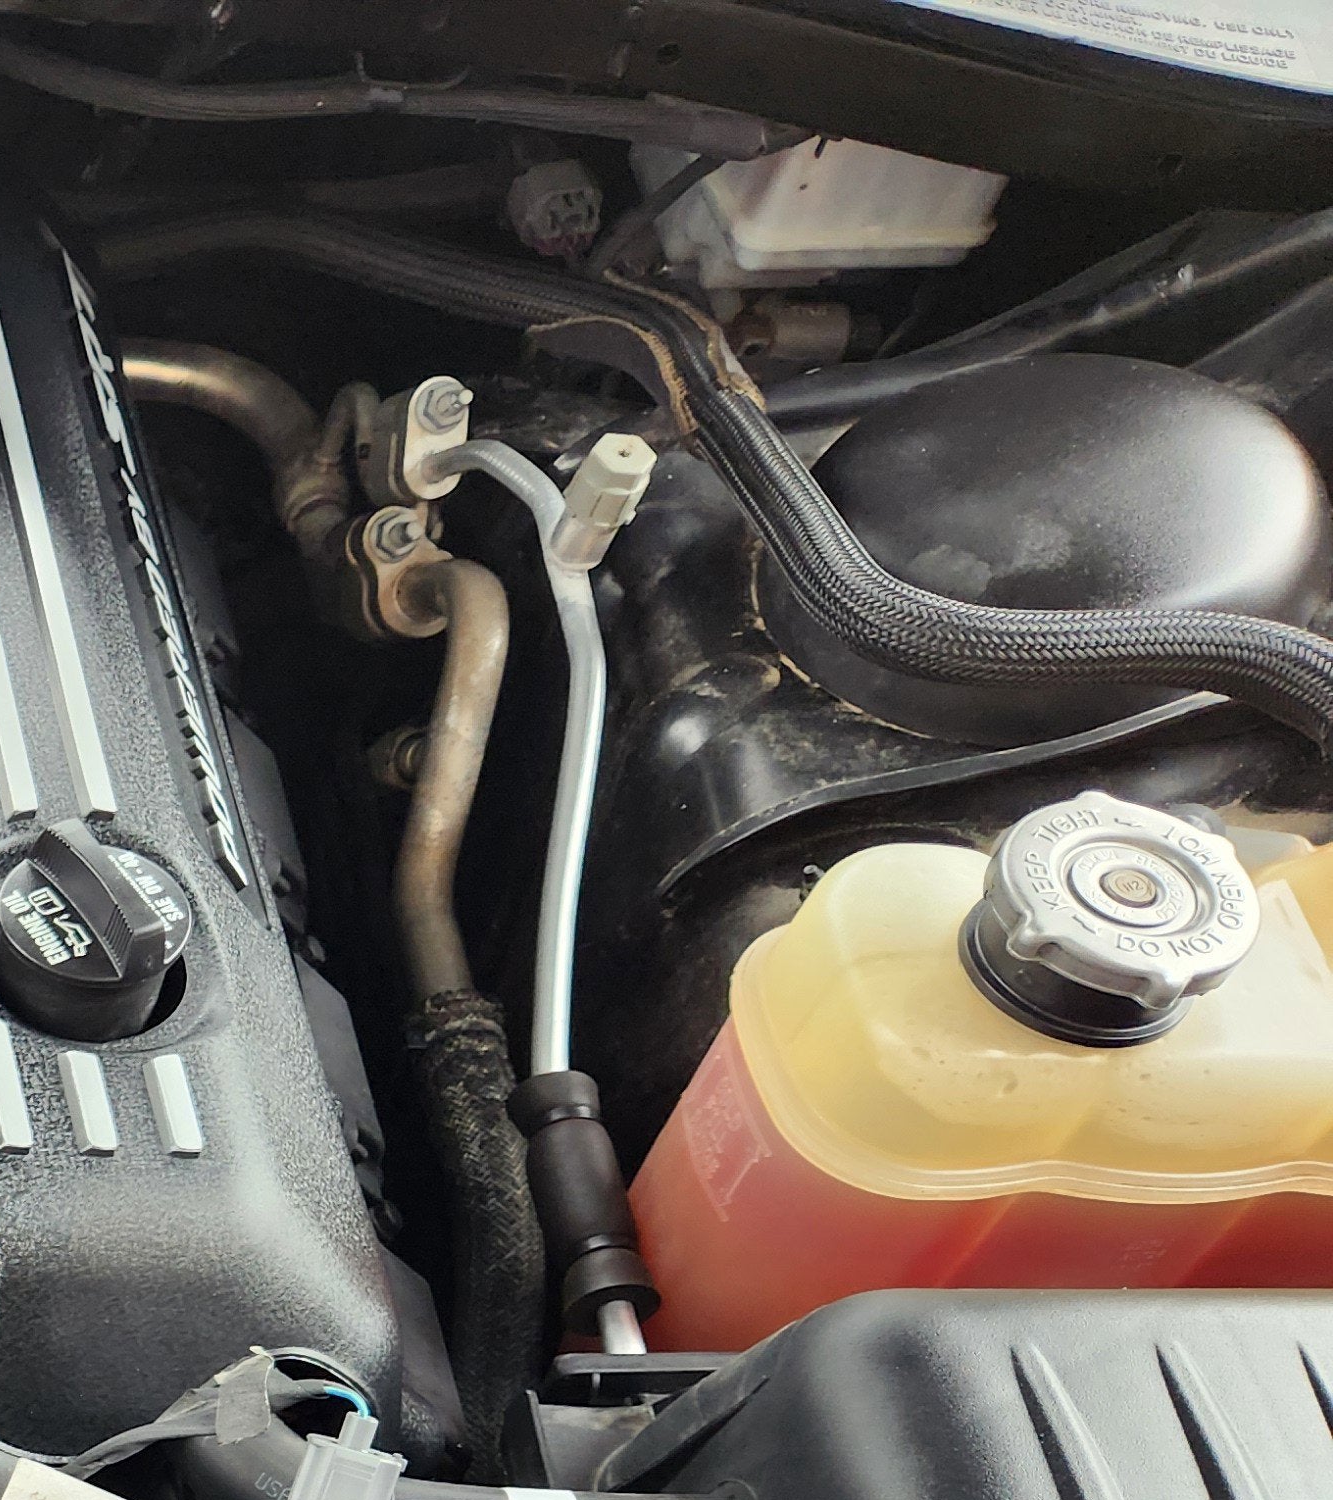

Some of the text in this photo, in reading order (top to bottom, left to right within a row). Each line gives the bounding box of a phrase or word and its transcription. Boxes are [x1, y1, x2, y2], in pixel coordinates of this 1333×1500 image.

[1033, 809, 1103, 844] TIGHT
[158, 896, 185, 922] SAE
[1024, 851, 1068, 911] KEEP
[2, 889, 72, 966] ENGINE OIL
[1115, 932, 1163, 958] DO
[1167, 928, 1224, 958] NOT
[1209, 870, 1245, 930] OPEN
